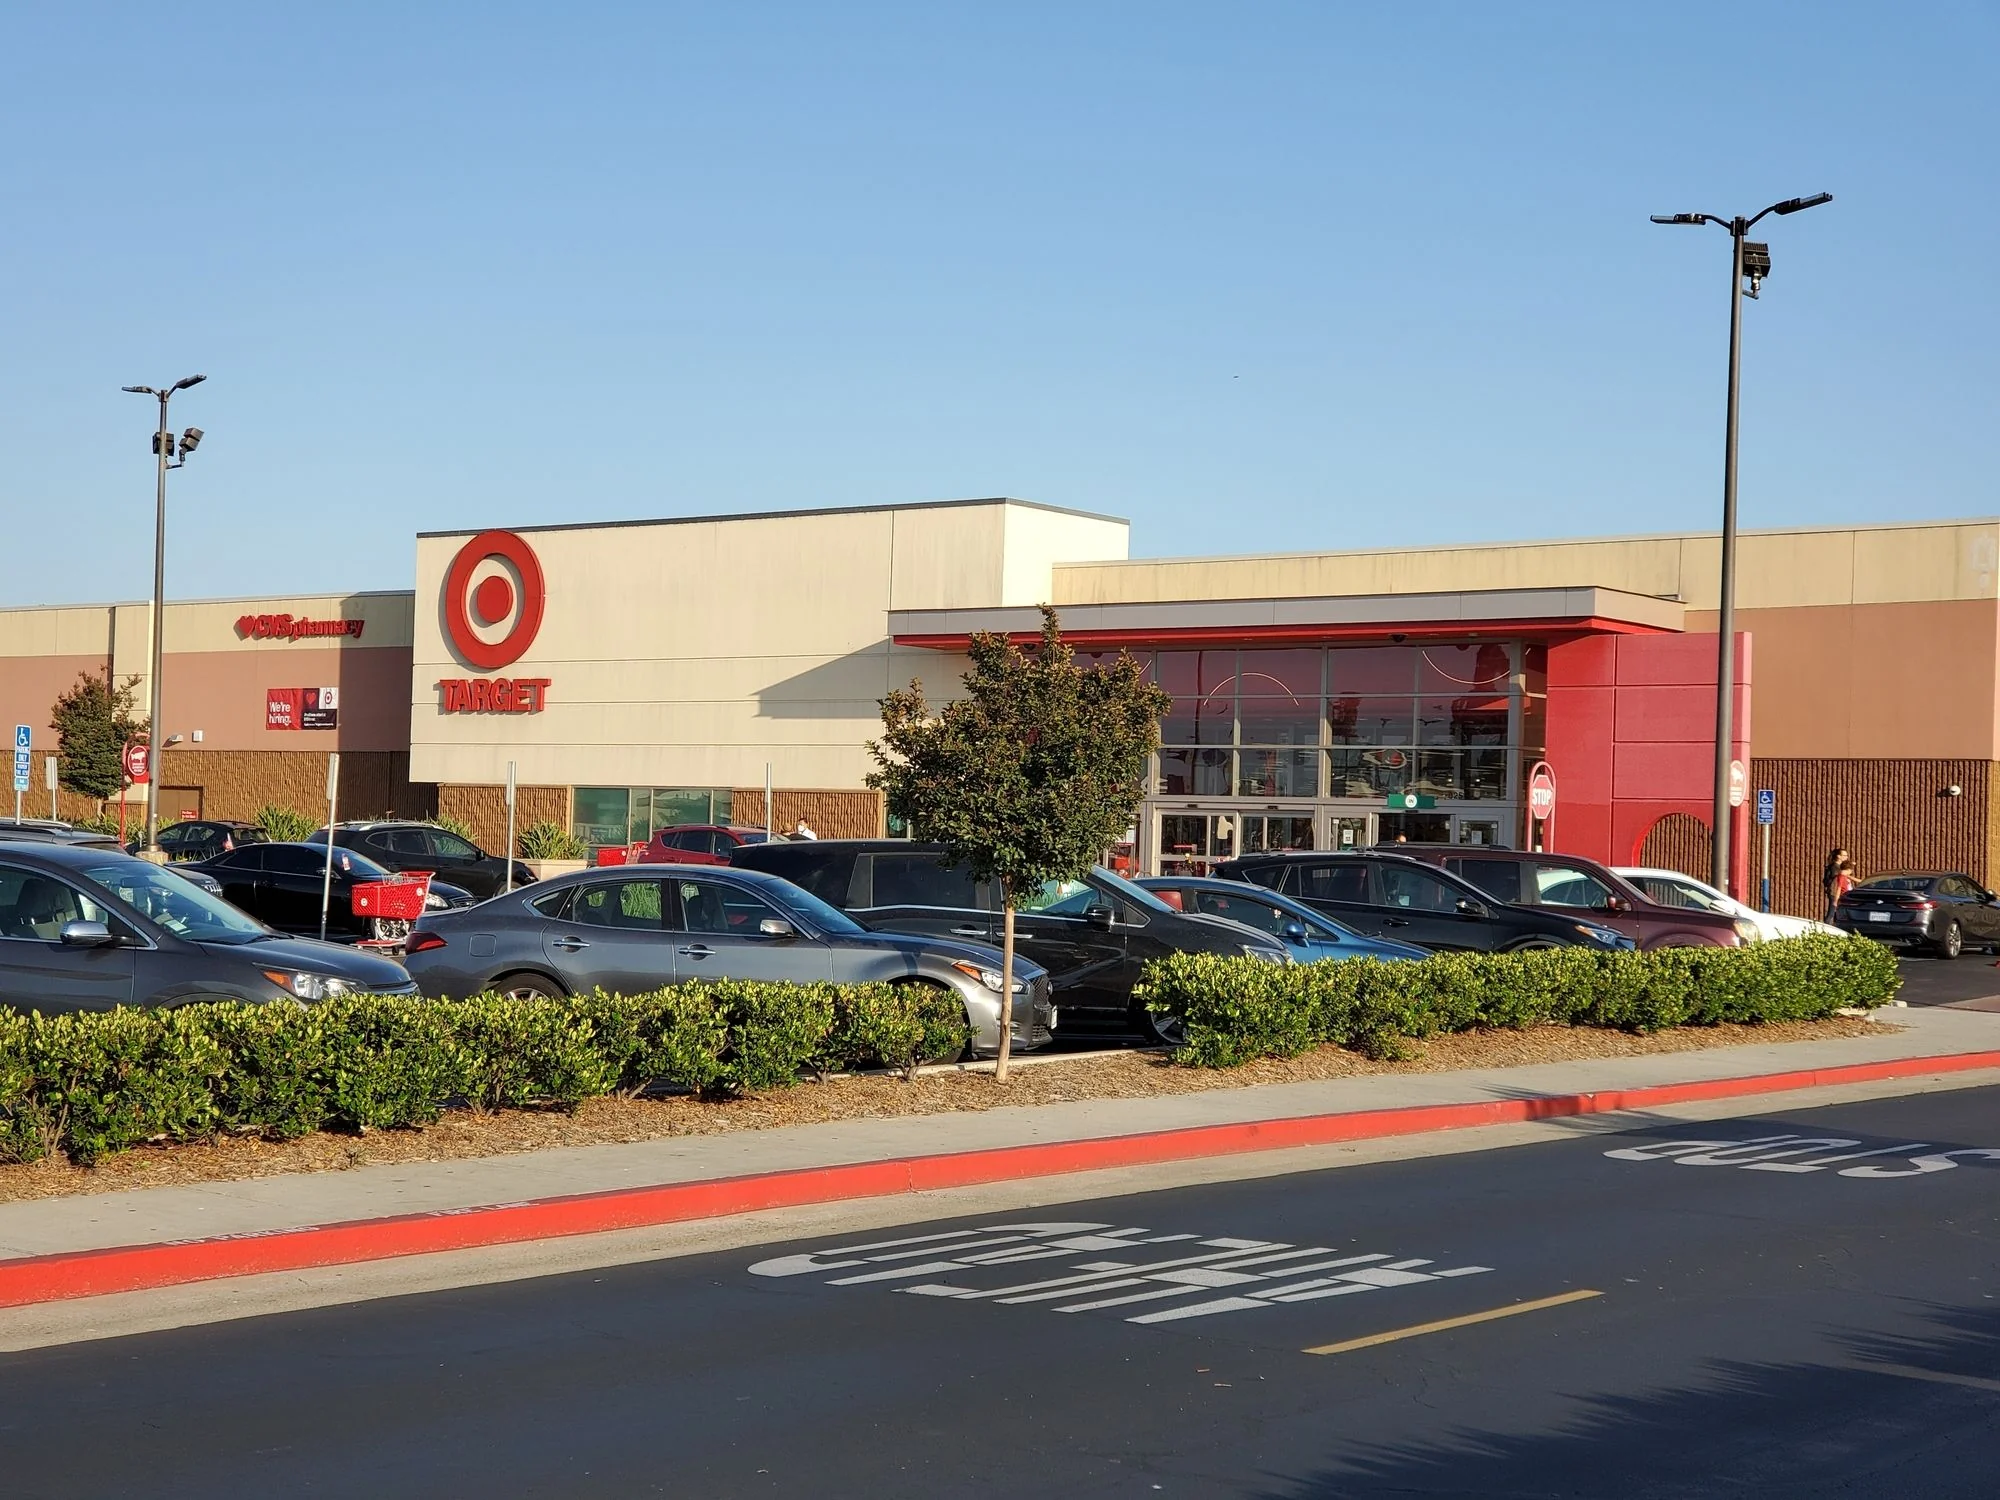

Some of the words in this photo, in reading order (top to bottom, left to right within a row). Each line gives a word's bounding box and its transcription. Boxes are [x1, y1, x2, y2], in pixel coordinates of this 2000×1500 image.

[255, 614, 293, 637] CVS
[292, 617, 365, 640] pharmacy
[269, 702, 290, 712] We're
[440, 678, 552, 711] TARGET
[269, 713, 292, 726] hiring.
[1532, 788, 1552, 805] STOP
[1602, 1134, 2000, 1178] STOP
[746, 1222, 1495, 1324] AHEAD
